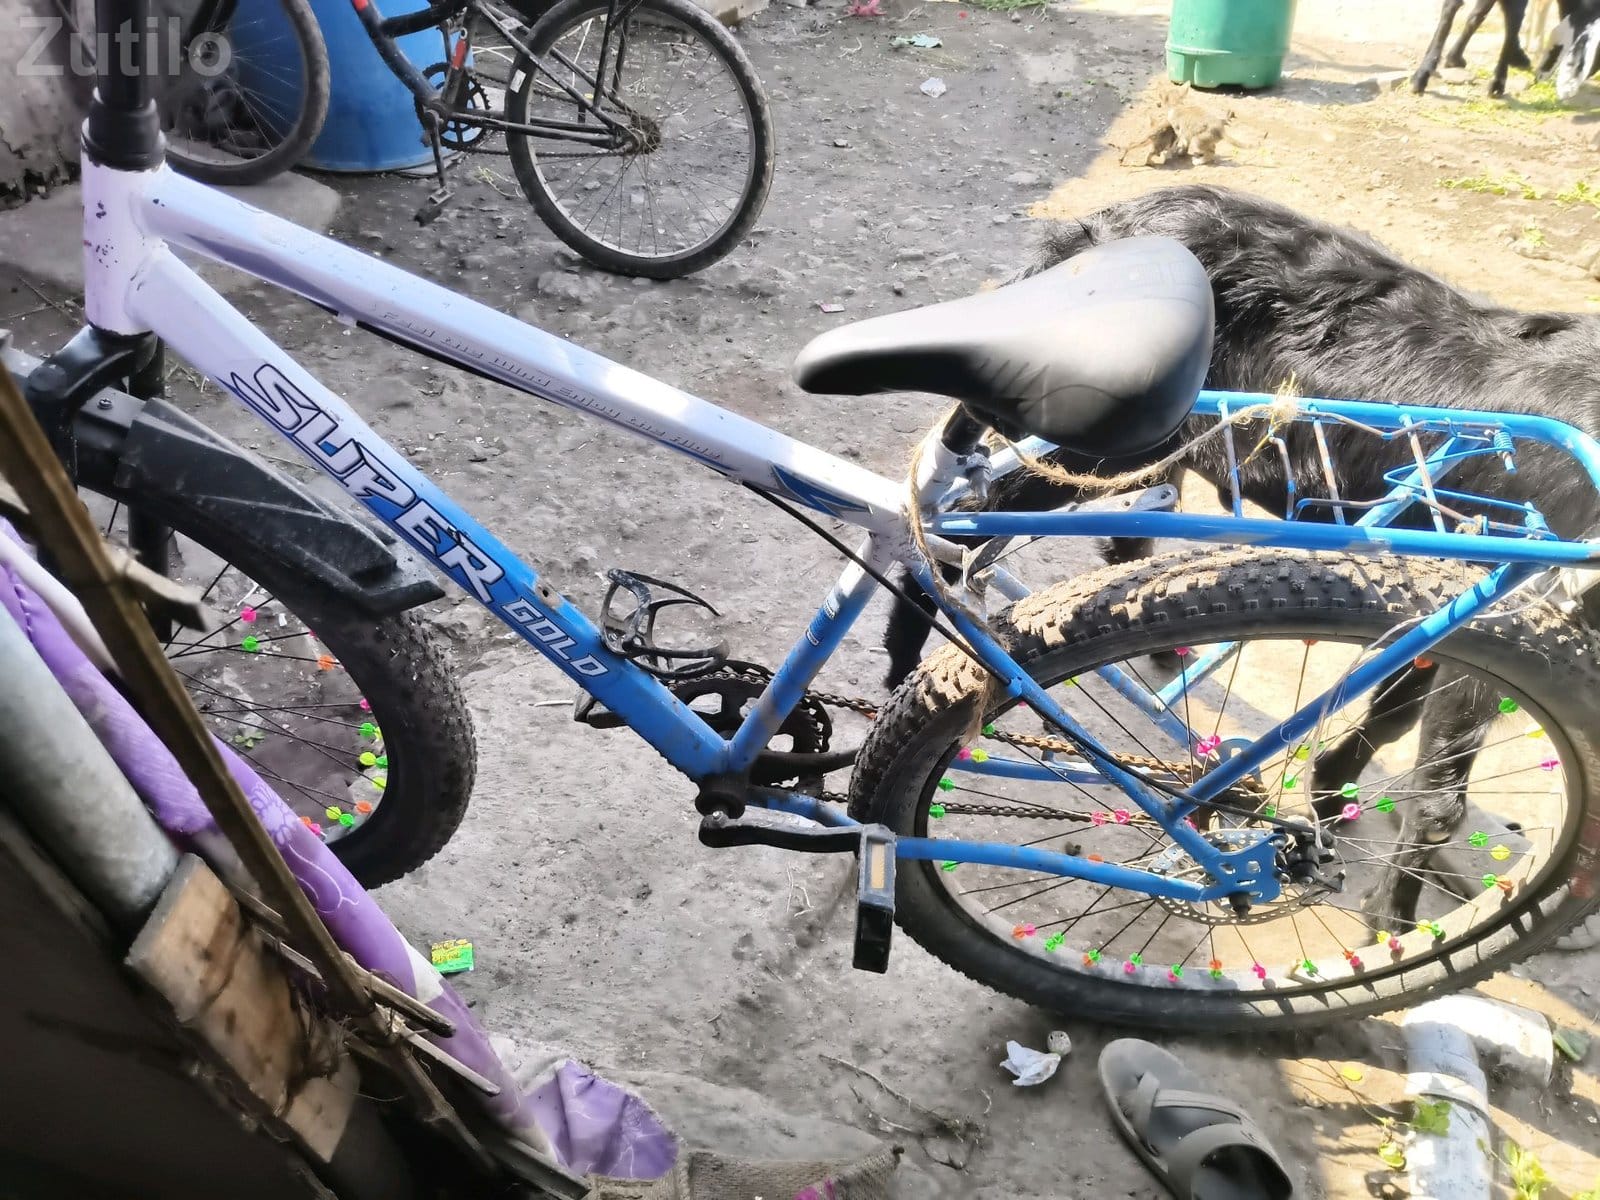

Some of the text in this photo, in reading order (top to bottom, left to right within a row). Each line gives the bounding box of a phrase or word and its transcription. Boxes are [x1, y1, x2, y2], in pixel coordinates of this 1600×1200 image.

[554, 385, 622, 419] Enjoy
[231, 362, 609, 678] SUPER GOLD
